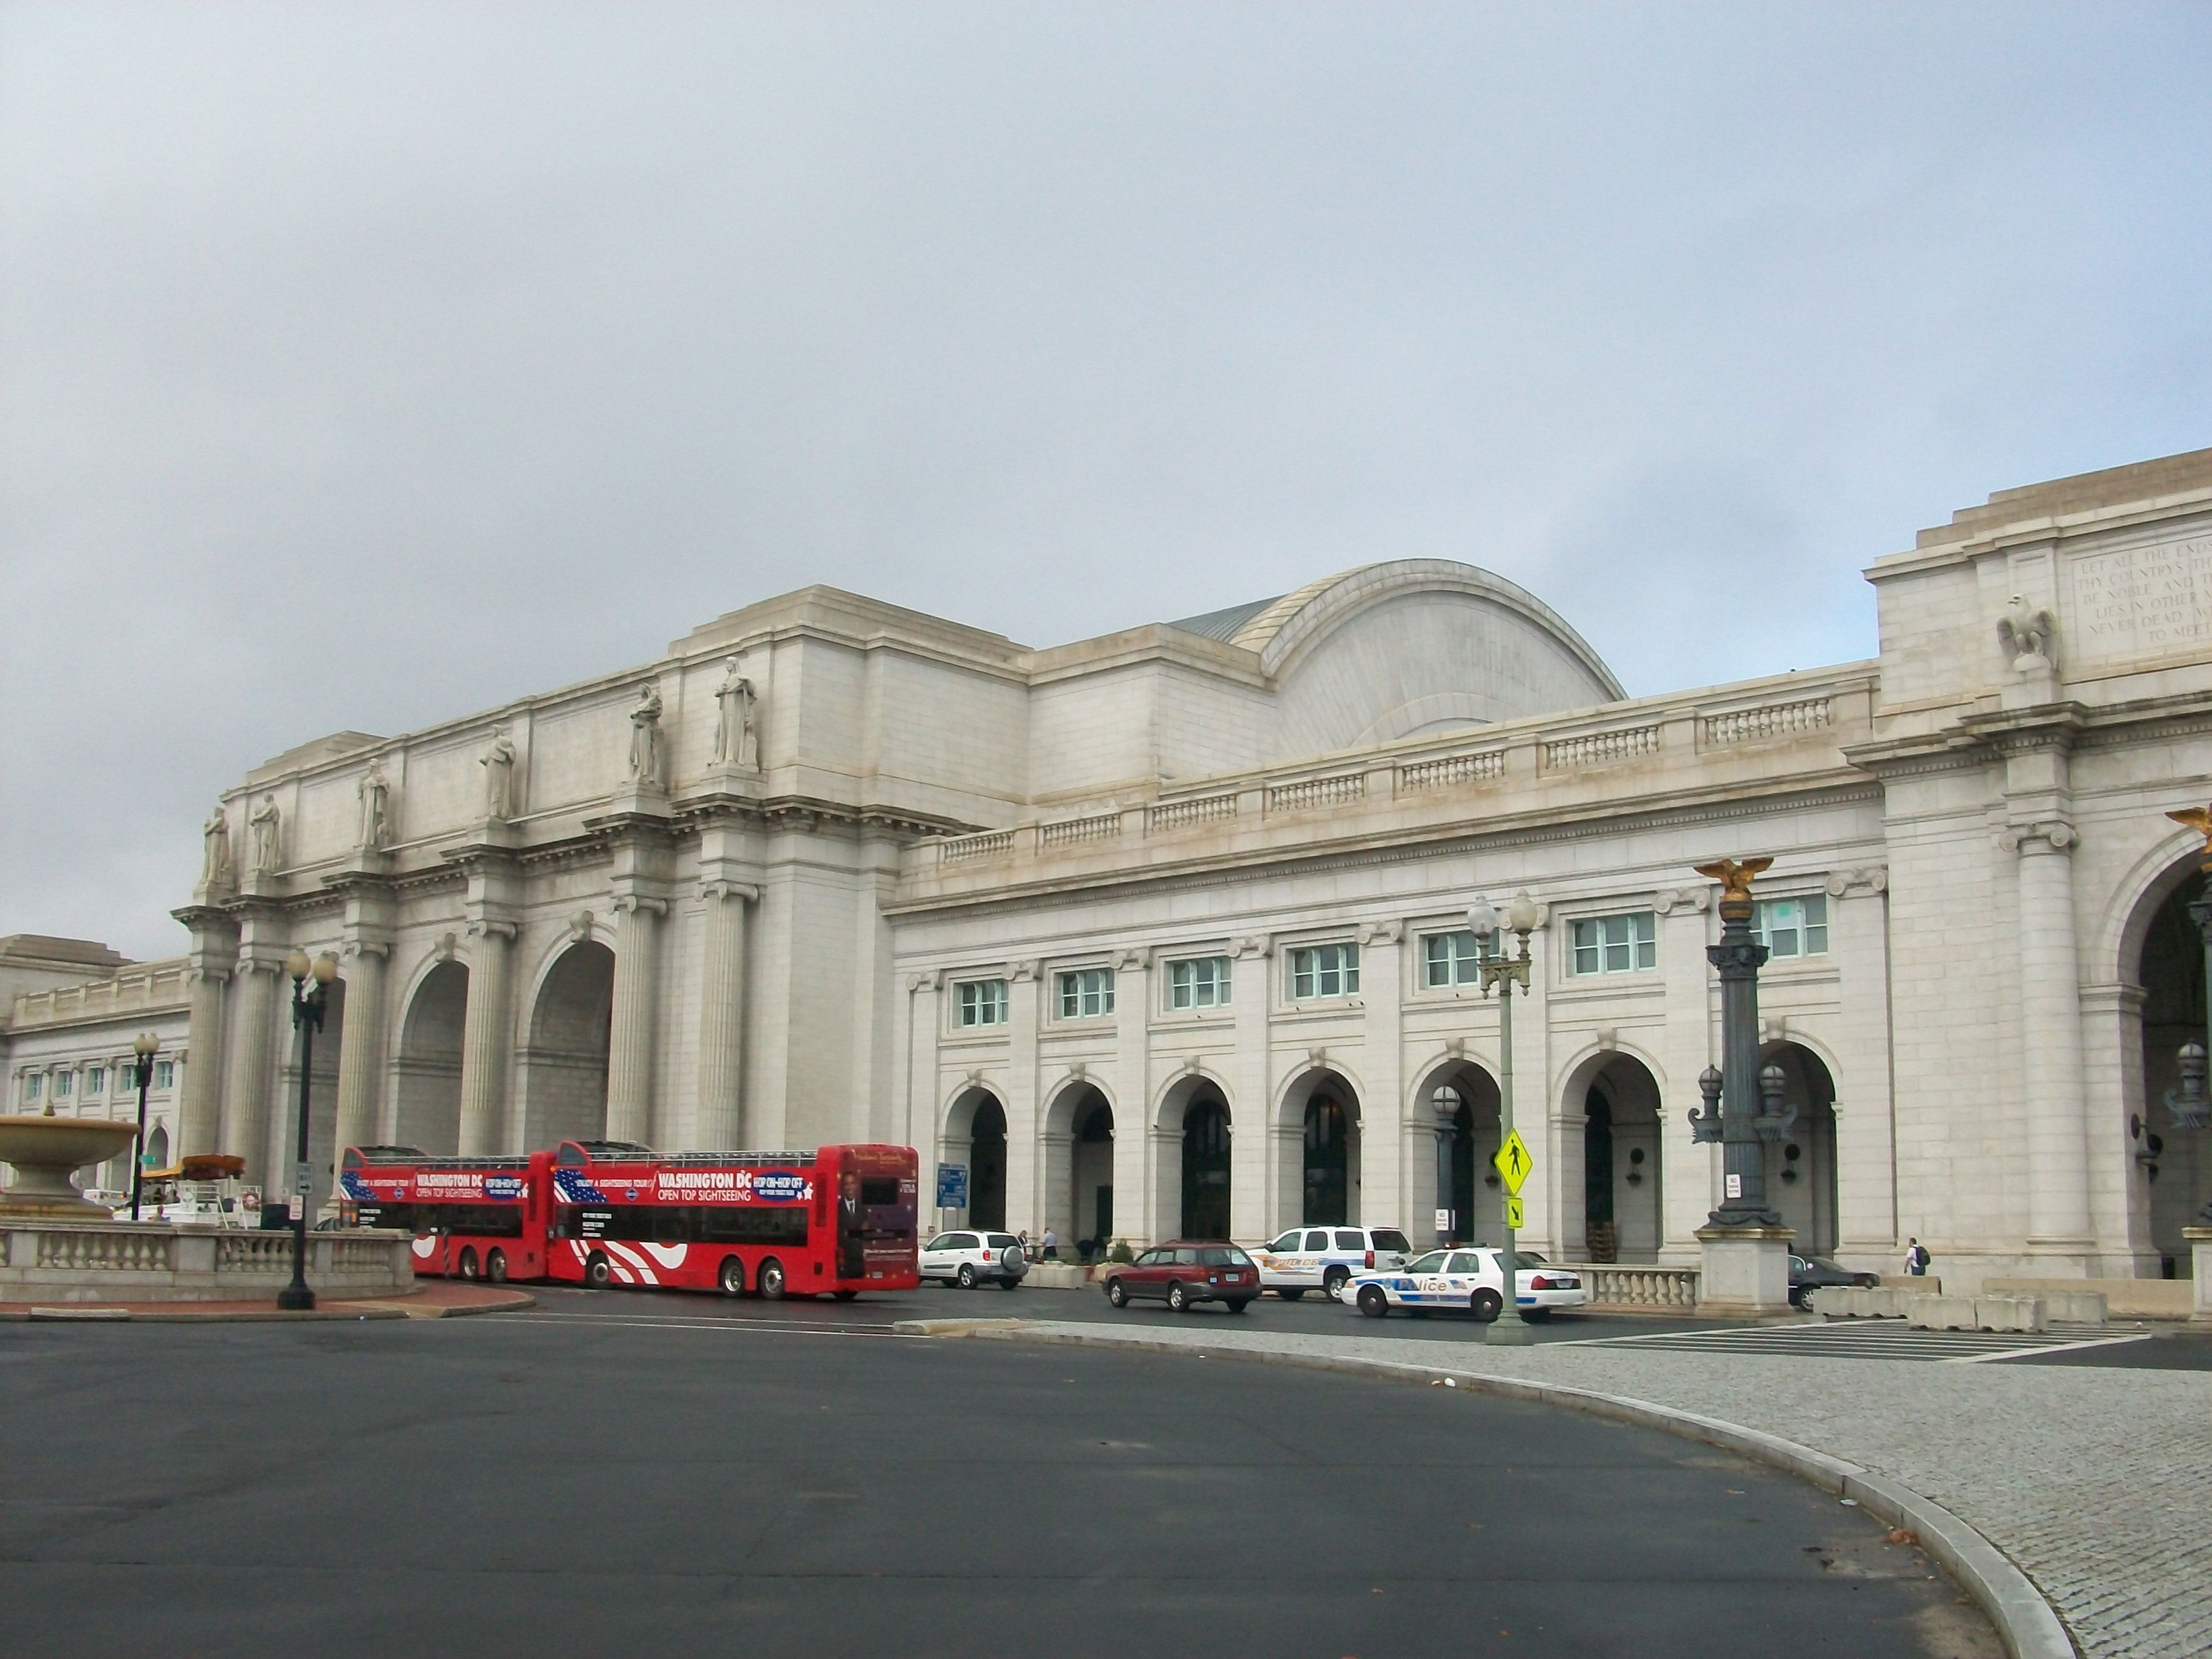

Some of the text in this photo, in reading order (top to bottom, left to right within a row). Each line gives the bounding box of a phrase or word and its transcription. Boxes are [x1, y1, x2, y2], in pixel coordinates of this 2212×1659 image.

[2081, 560, 2105, 574] LET
[2115, 554, 2137, 567] ALL
[2145, 549, 2169, 563] THE
[2078, 577, 2102, 591] THY
[2083, 592, 2101, 605] BE
[2108, 583, 2151, 599] NOBLE
[2165, 577, 2194, 591] AND
[2096, 605, 2125, 619] LIES
[2130, 601, 2143, 614] IN
[2150, 592, 2197, 609] OTHER
[2088, 619, 2136, 635] NEVER
[2141, 610, 2182, 628] DEAD
[2149, 629, 2166, 643] TO
[417, 1174, 470, 1186] WASHINGTON
[471, 1174, 482, 1187] DC
[658, 1172, 752, 1188] WASHINGTON DC
[416, 1188, 432, 1197] OPEN
[433, 1188, 443, 1198] TOP
[445, 1188, 482, 1198] SIGHTSEEING
[658, 1189, 679, 1200] OPEN
[681, 1189, 696, 1201] TOP
[698, 1189, 751, 1202] SIGHTSEEING
[1275, 1258, 1318, 1266] POLICE
[1399, 1279, 1447, 1291] Police
